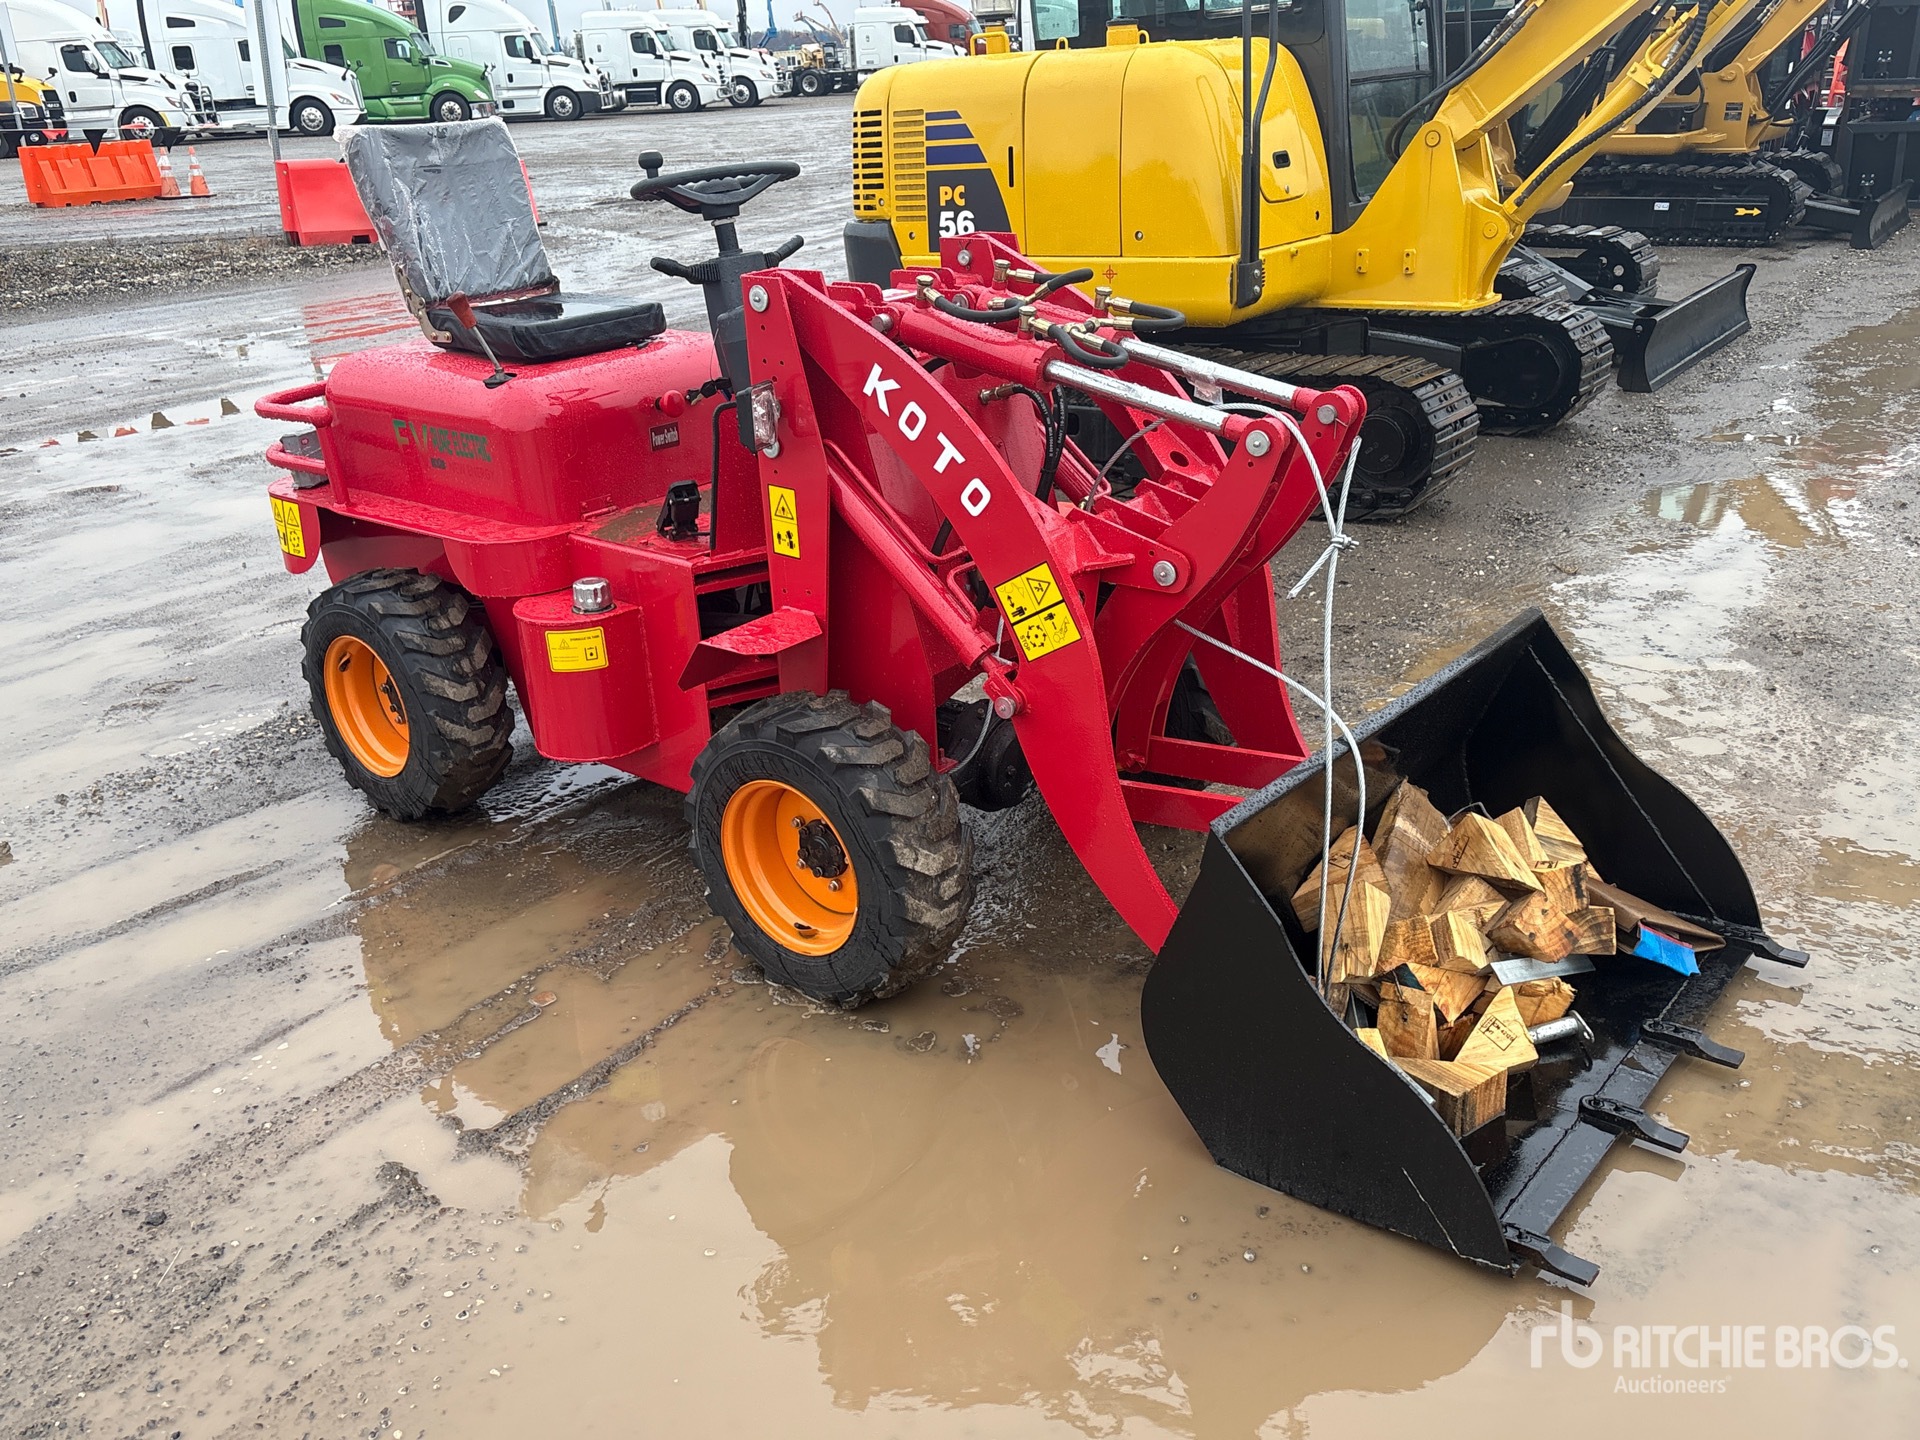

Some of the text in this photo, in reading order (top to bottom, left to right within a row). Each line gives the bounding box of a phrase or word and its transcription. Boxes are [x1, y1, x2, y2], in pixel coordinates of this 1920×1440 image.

[939, 184, 966, 207] PC
[938, 209, 976, 238] 56
[862, 362, 992, 517] KOTO
[1019, 634, 1031, 652] STOP
